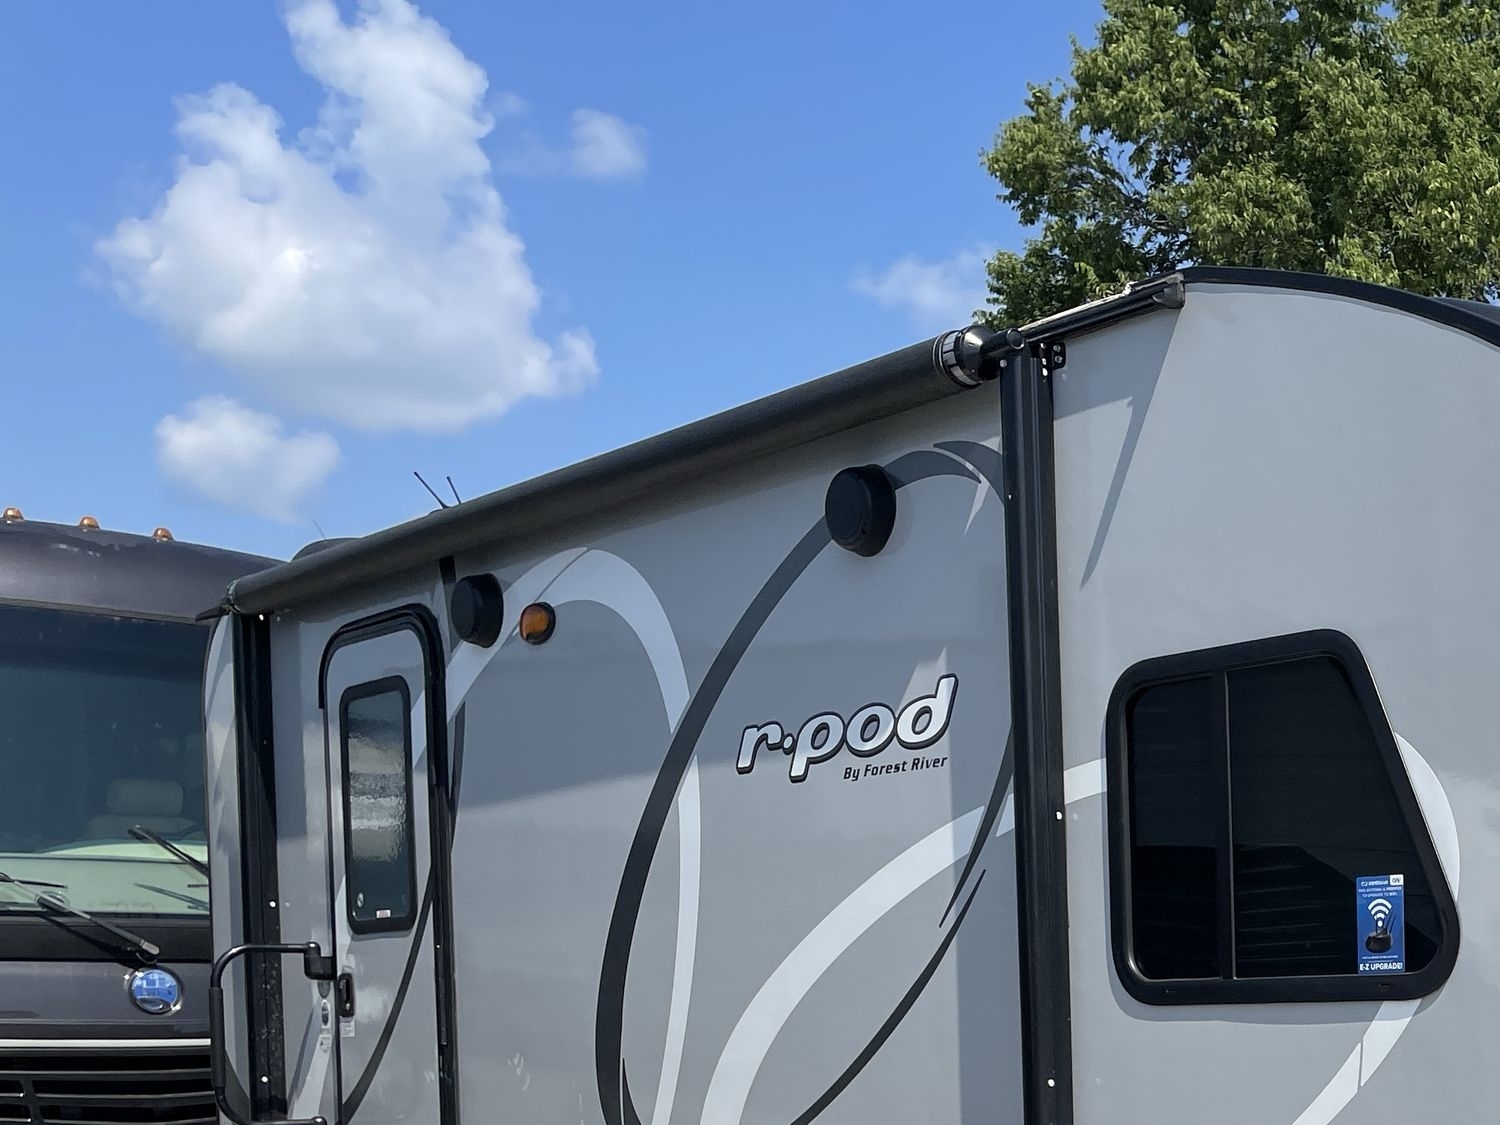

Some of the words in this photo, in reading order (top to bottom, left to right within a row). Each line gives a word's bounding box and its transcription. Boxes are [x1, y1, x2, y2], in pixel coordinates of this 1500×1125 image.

[843, 767, 861, 782] By
[863, 760, 908, 778] Forest
[910, 756, 948, 771] River
